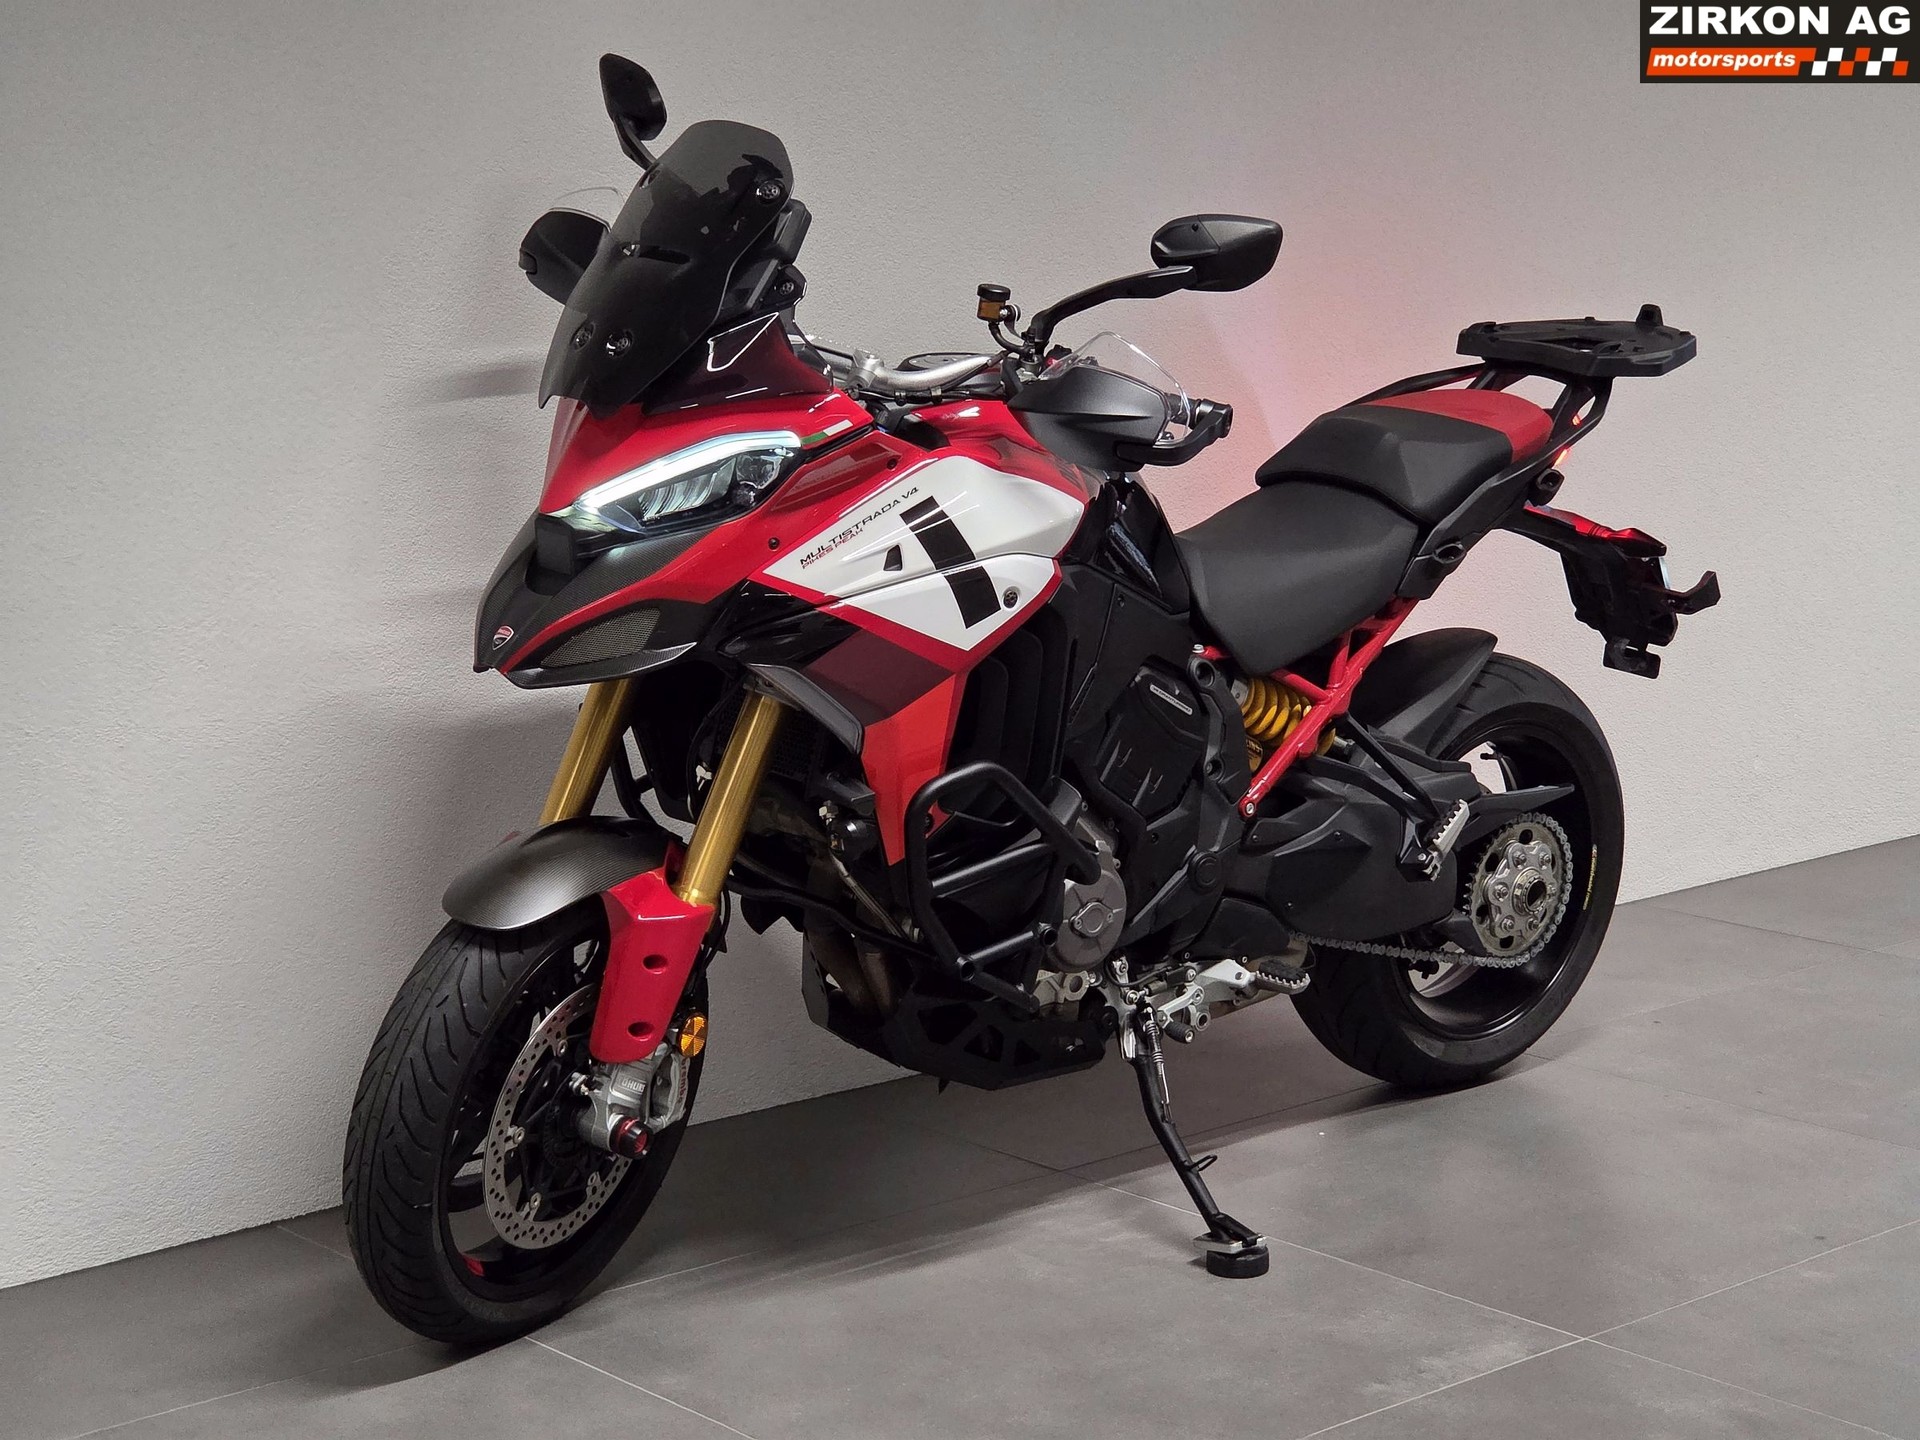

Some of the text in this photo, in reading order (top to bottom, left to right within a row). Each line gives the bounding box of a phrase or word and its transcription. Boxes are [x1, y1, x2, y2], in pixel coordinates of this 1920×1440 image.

[800, 486, 919, 565] MULTISTRADA V4
[802, 527, 863, 569] PIKES PEAK
